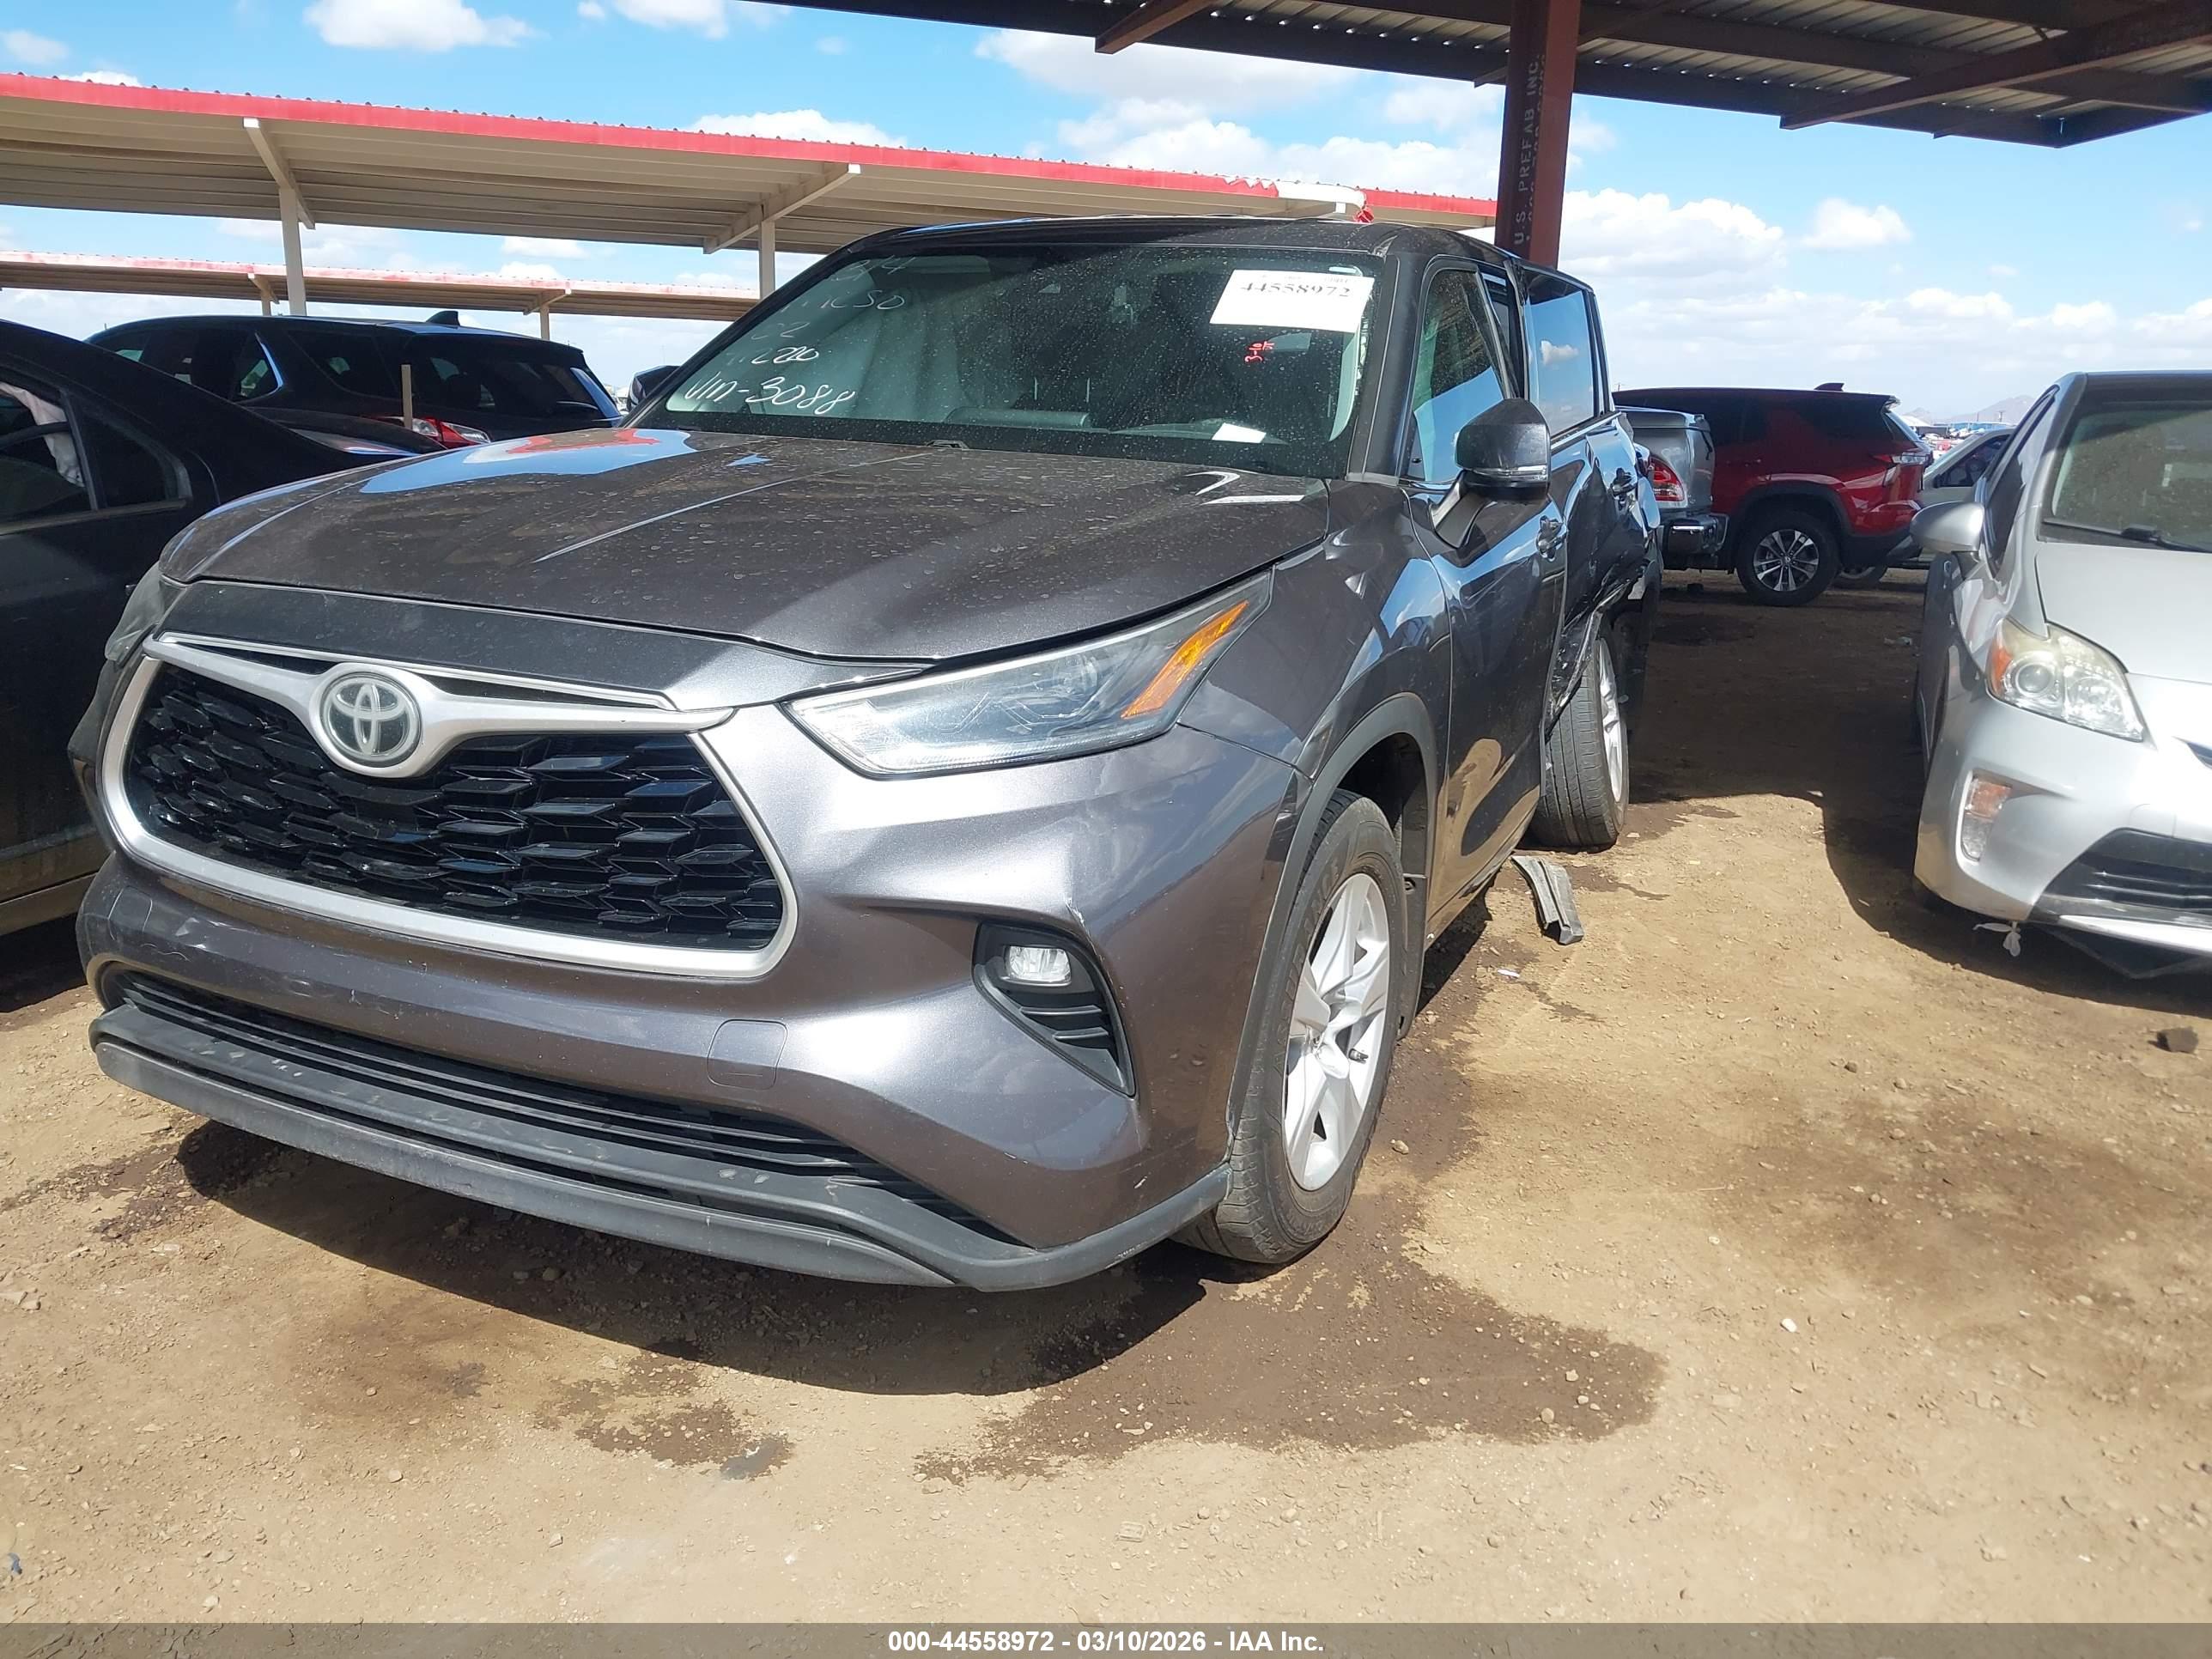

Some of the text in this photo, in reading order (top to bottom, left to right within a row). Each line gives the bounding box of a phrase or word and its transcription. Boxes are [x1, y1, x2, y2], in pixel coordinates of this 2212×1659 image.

[1526, 54, 1540, 96] INC.
[1518, 108, 1535, 191] PREFAB
[1514, 203, 1528, 245] U.S.
[1239, 282, 1351, 297] 44558972
